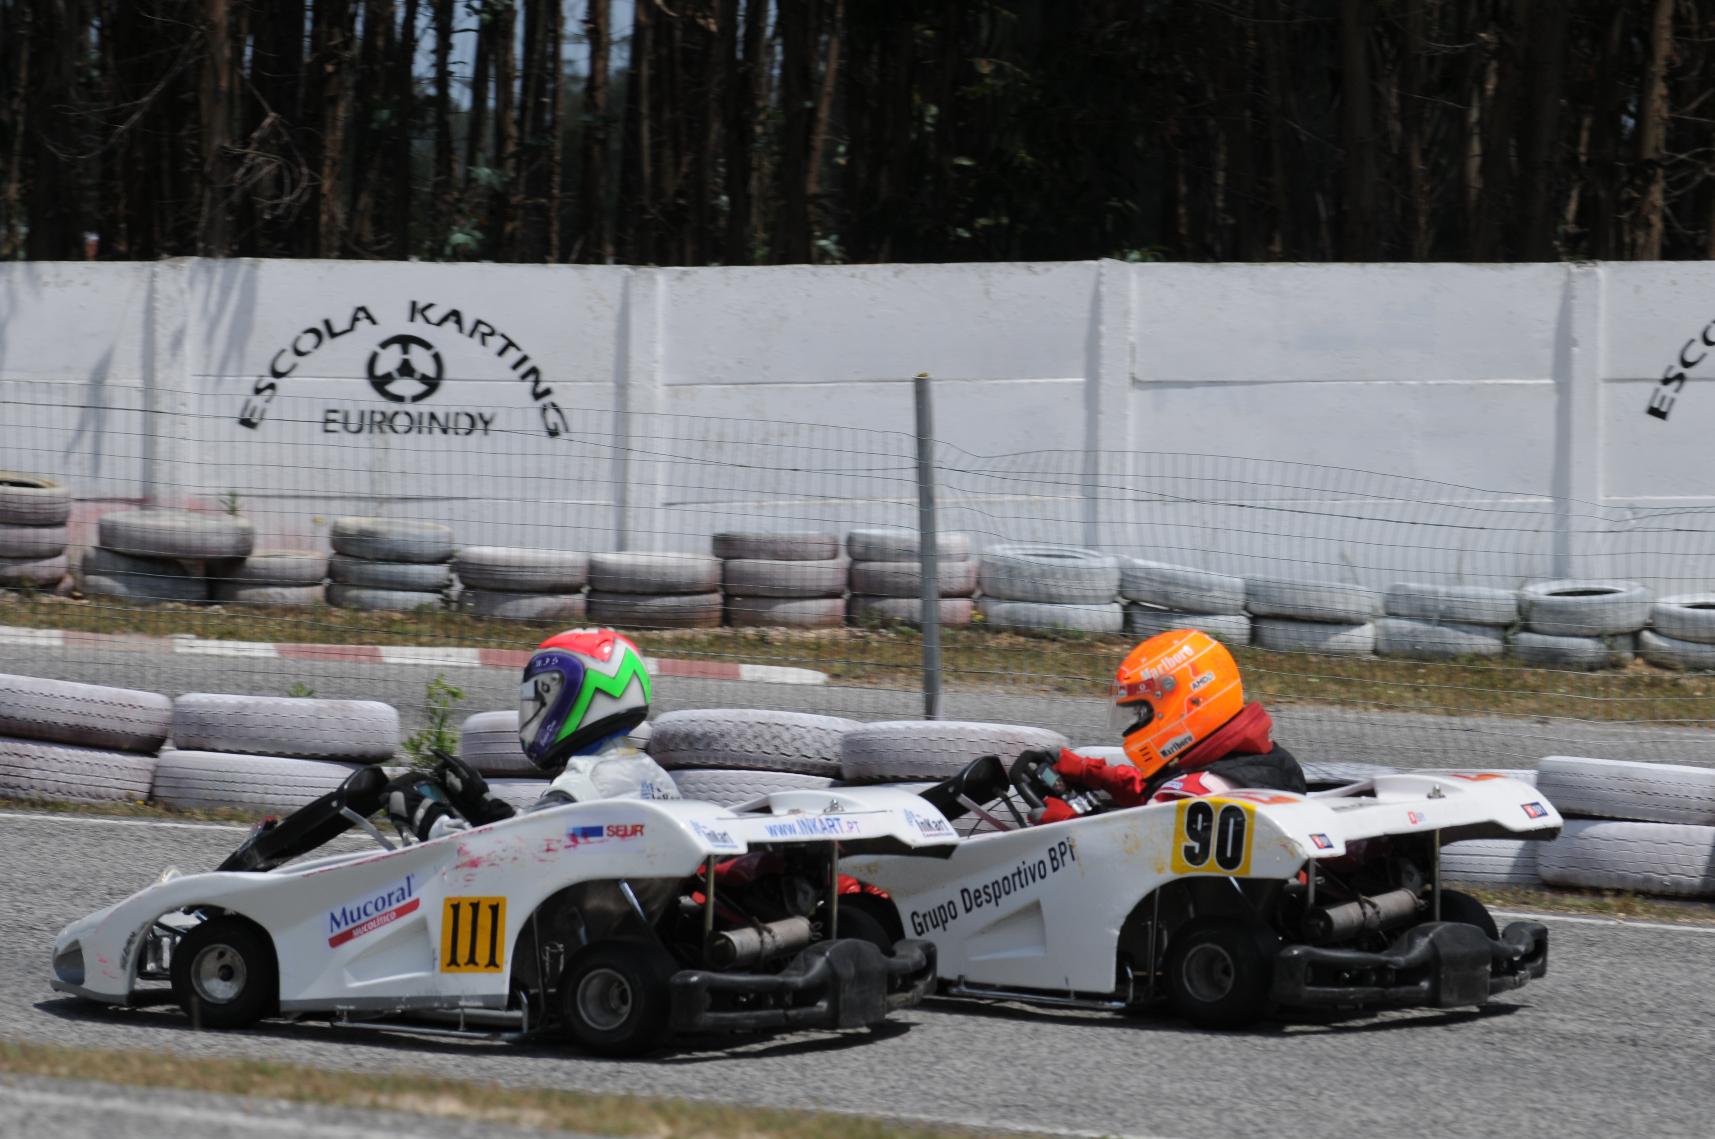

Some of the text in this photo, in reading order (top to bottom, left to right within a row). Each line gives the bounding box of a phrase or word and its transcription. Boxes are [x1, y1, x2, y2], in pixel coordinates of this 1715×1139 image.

[239, 300, 570, 439] ESCOLA KARTING
[322, 408, 498, 437] EUROINDY
[1159, 734, 1194, 758] Marlboro
[1183, 800, 1247, 871] 90
[329, 874, 413, 933] Mucoral
[910, 899, 958, 937] Grupo
[960, 860, 1047, 914] Desportivo
[446, 901, 500, 969] 111
